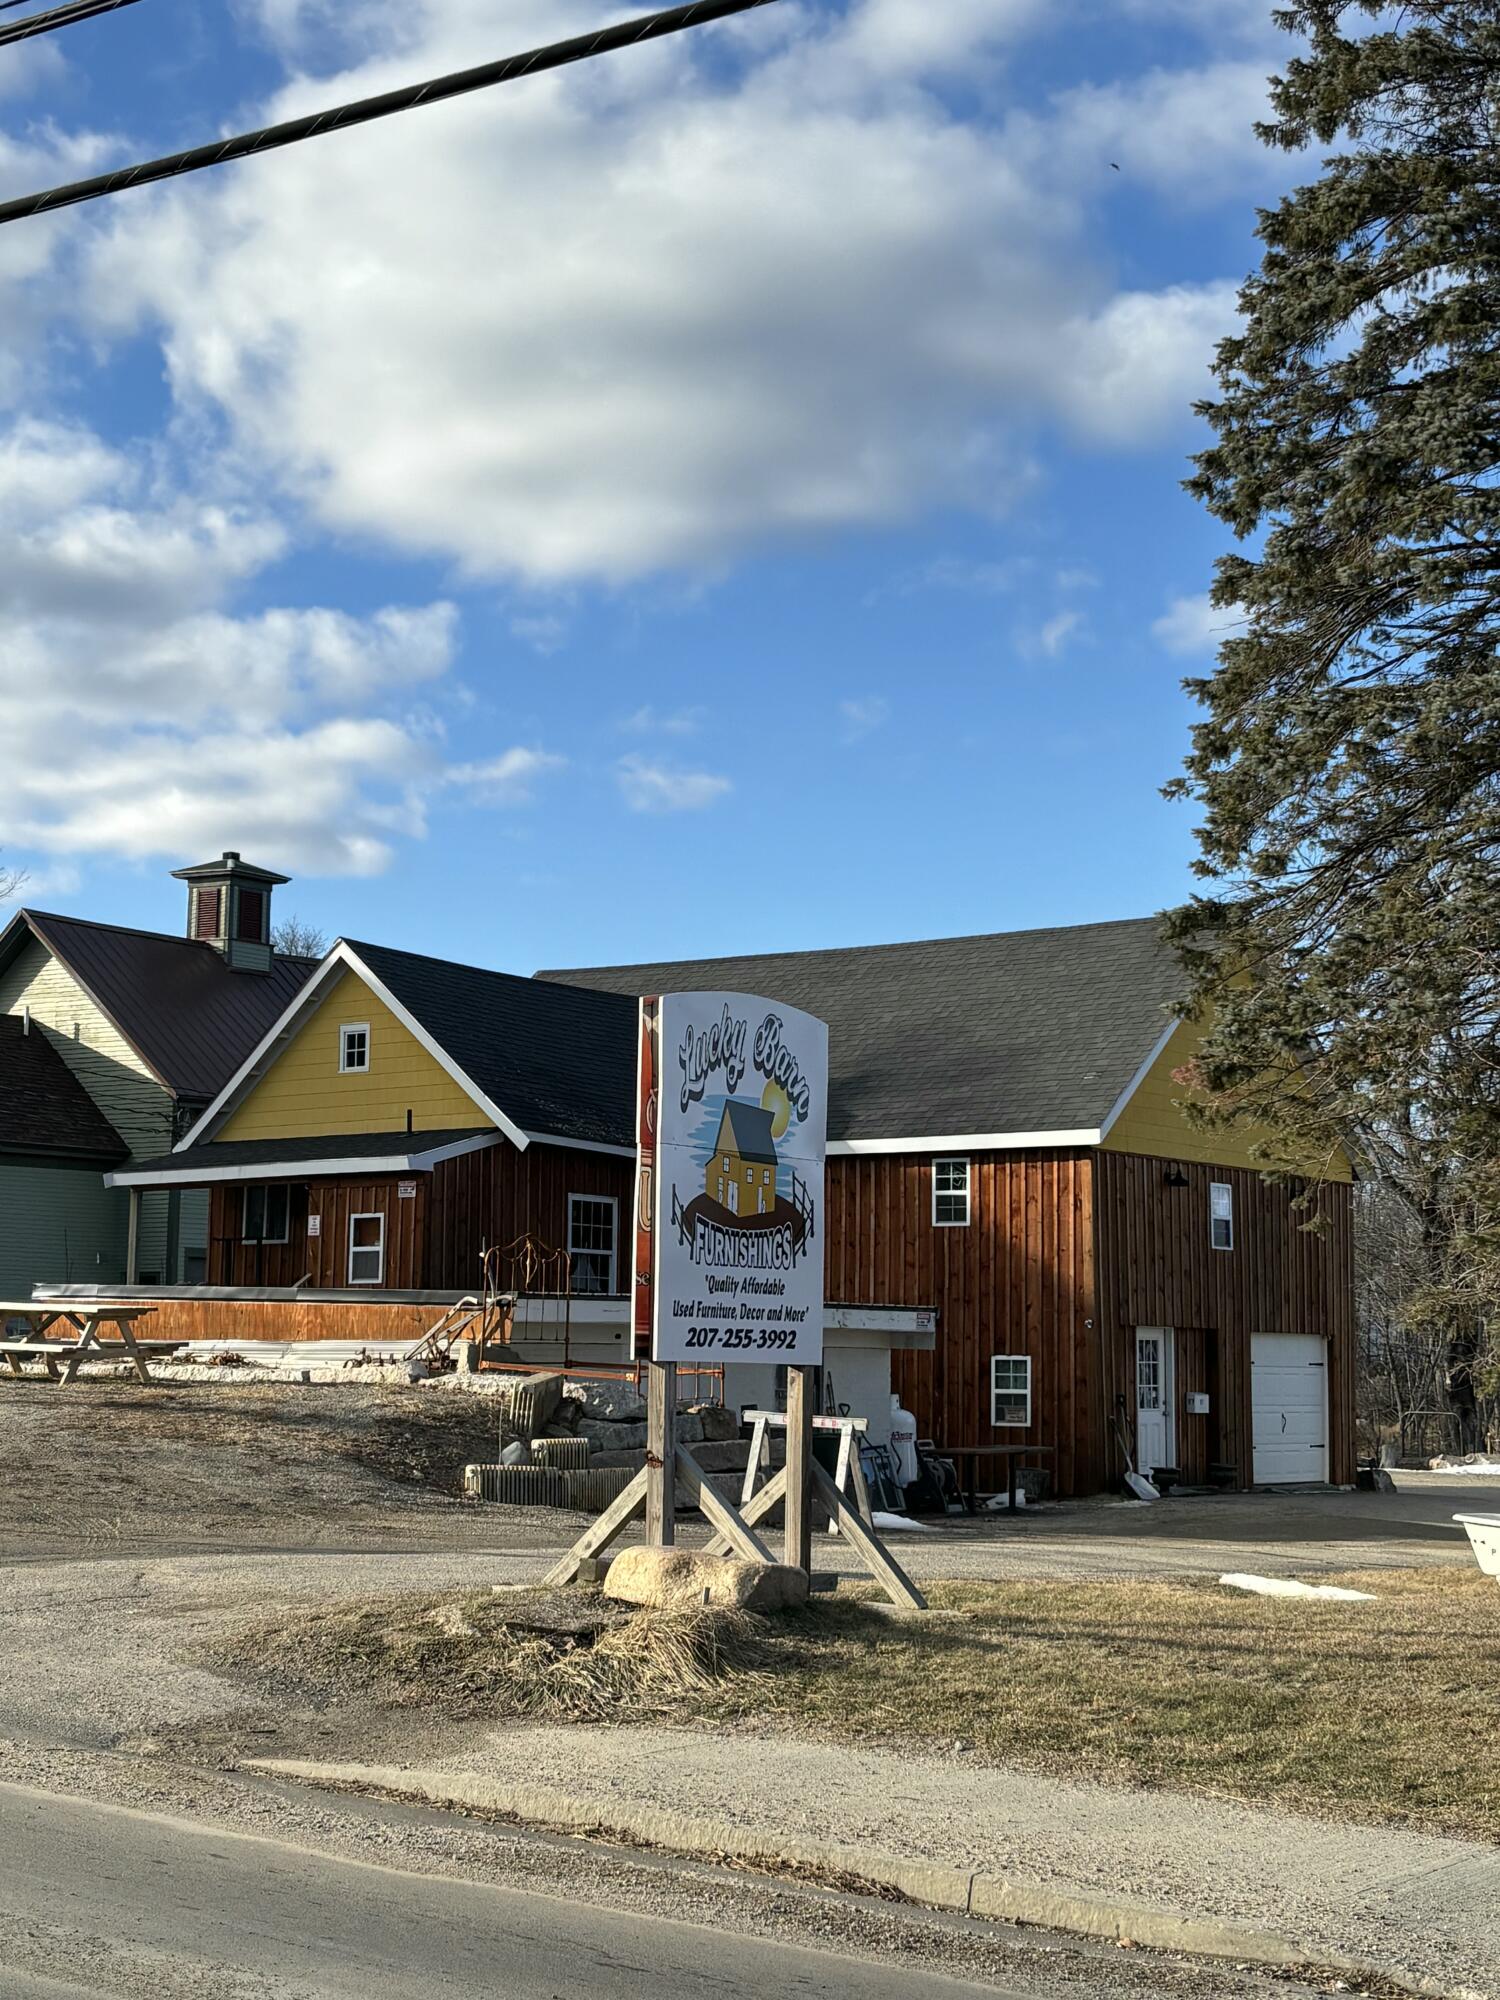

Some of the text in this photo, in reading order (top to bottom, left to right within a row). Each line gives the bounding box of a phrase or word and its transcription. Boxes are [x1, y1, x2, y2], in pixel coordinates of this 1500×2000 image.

[679, 1002, 747, 1113] Lucky
[753, 1013, 810, 1123] Barn
[694, 1212, 793, 1270] FURNISHINGS
[740, 1276, 785, 1296] Affordable
[672, 1299, 695, 1318] Used
[696, 1300, 737, 1321] Furniture,
[739, 1303, 766, 1320] Decor
[766, 1304, 784, 1321] and
[685, 1327, 797, 1349] 207-255-3992
